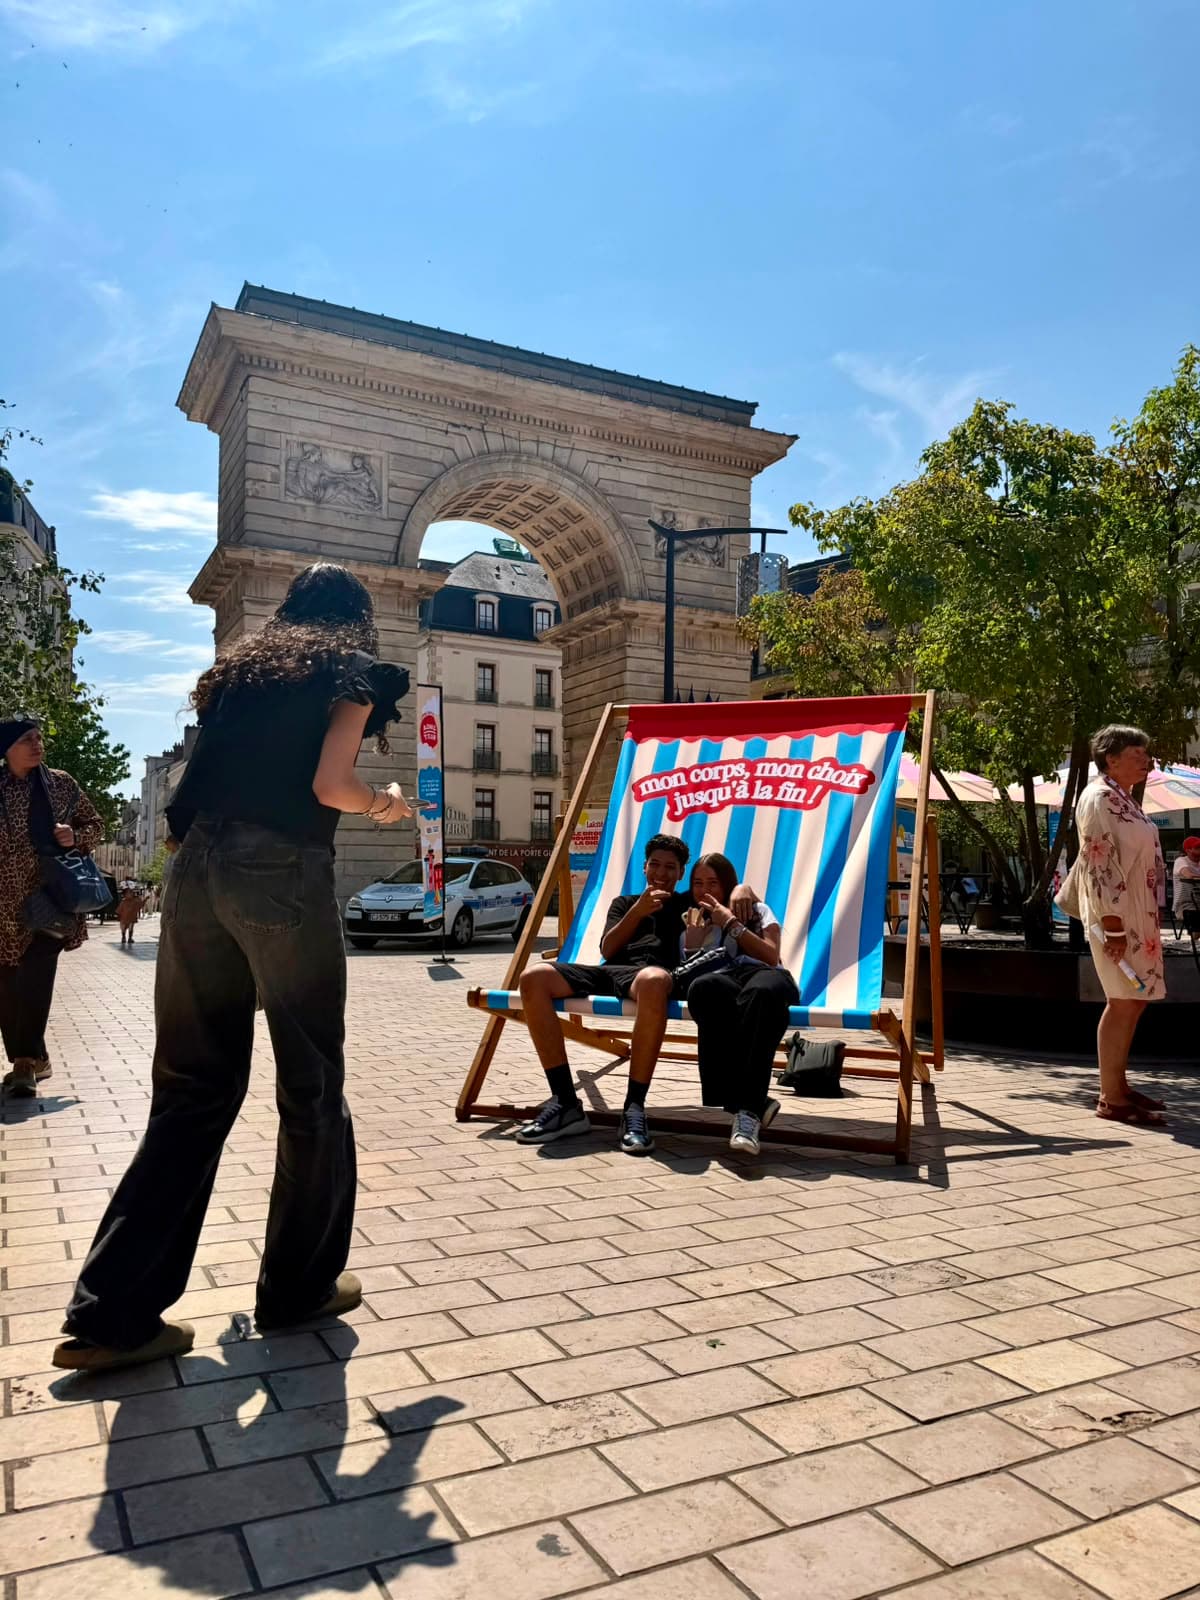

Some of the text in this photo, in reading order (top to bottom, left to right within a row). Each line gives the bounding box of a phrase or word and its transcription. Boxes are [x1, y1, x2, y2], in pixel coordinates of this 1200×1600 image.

[639, 762, 868, 796] mon corps, mon choix
[674, 780, 823, 816] jusqu'à la fin !
